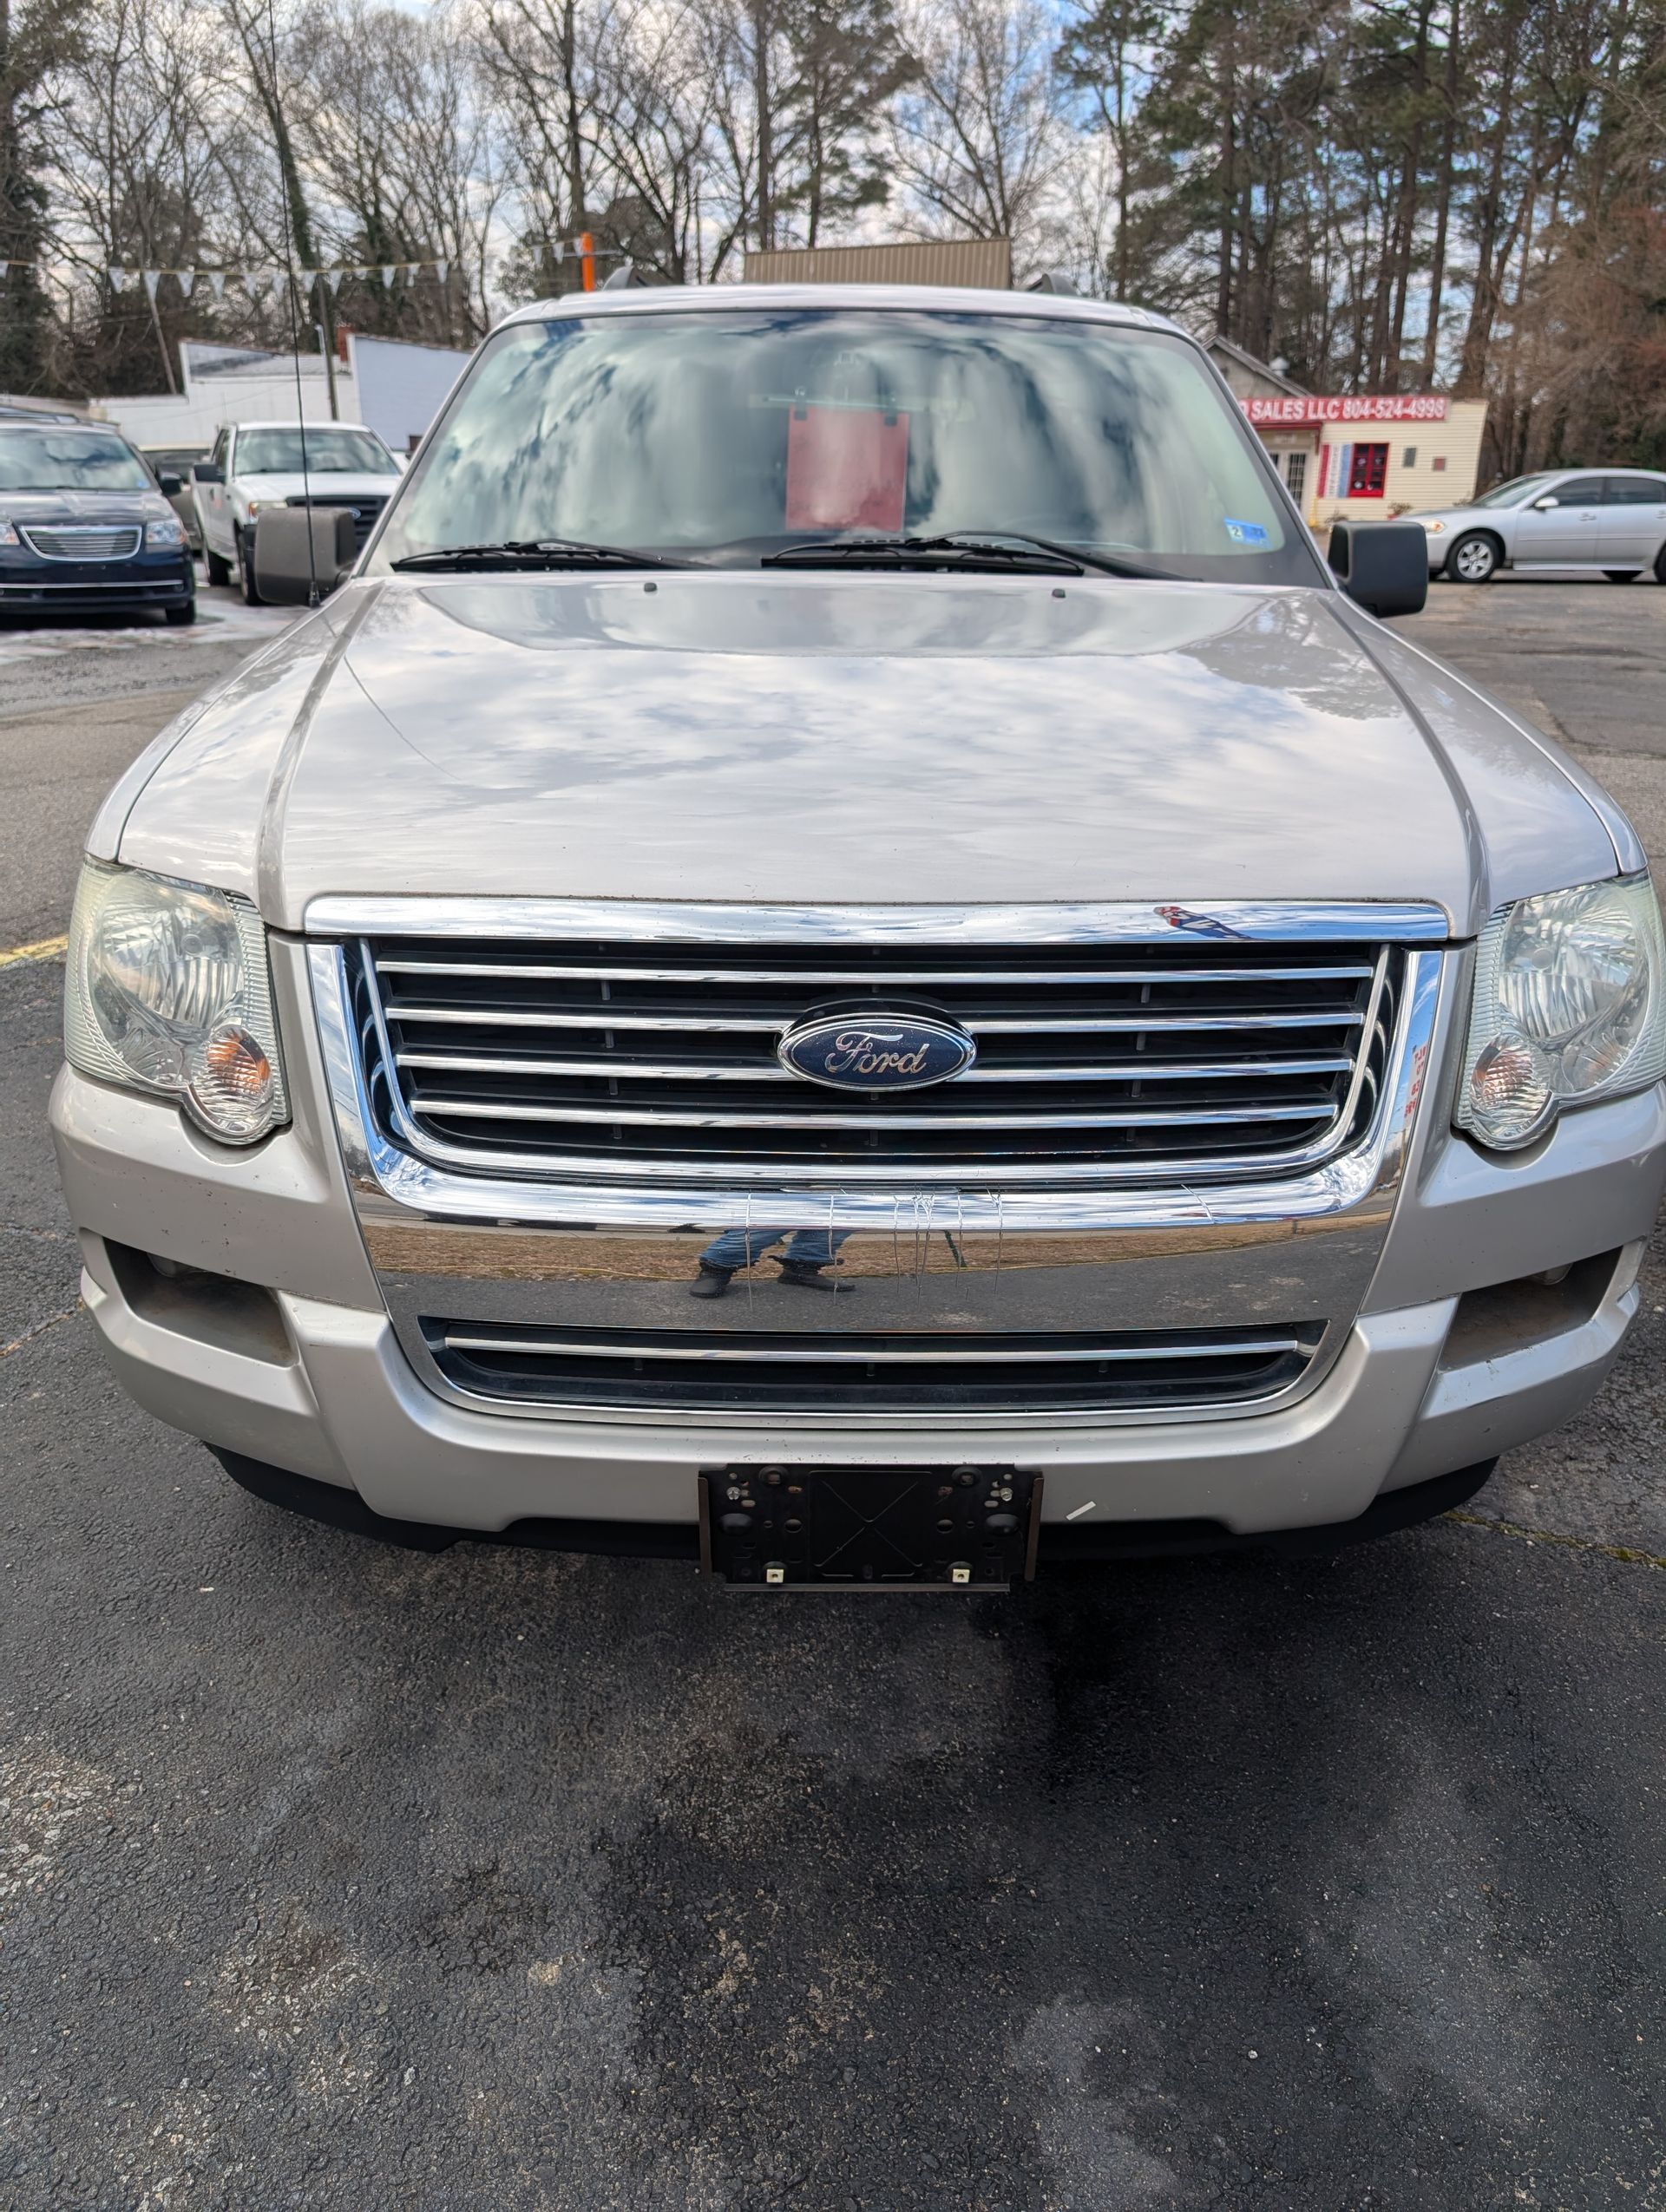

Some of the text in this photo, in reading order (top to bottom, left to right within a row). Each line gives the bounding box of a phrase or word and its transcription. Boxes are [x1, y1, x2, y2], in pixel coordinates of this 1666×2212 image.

[1251, 400, 1304, 420] SALES
[1308, 398, 1340, 419] LLC
[824, 1031, 930, 1074] Ford
